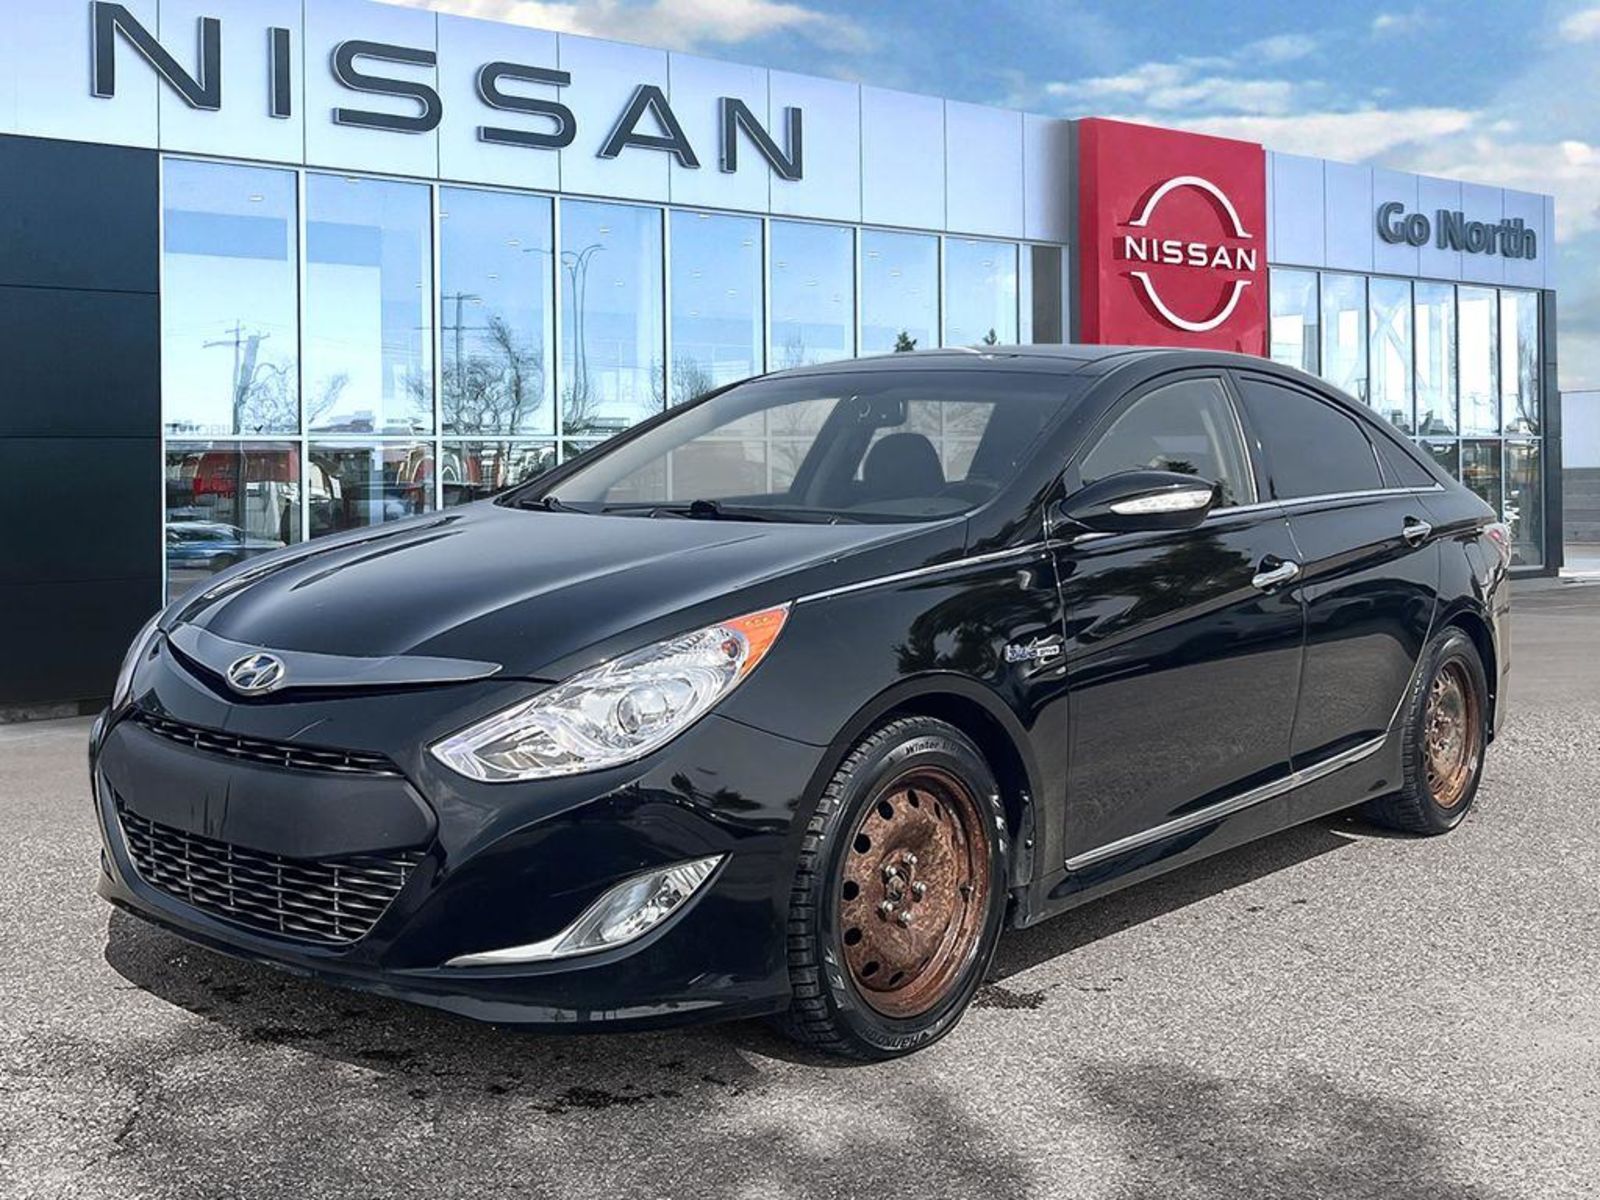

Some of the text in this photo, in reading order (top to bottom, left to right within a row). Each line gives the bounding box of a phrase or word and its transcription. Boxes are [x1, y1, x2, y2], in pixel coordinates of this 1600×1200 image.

[92, 1, 802, 180] NISSAN
[1124, 234, 1257, 272] NISSAN
[1378, 202, 1536, 259] Go North
